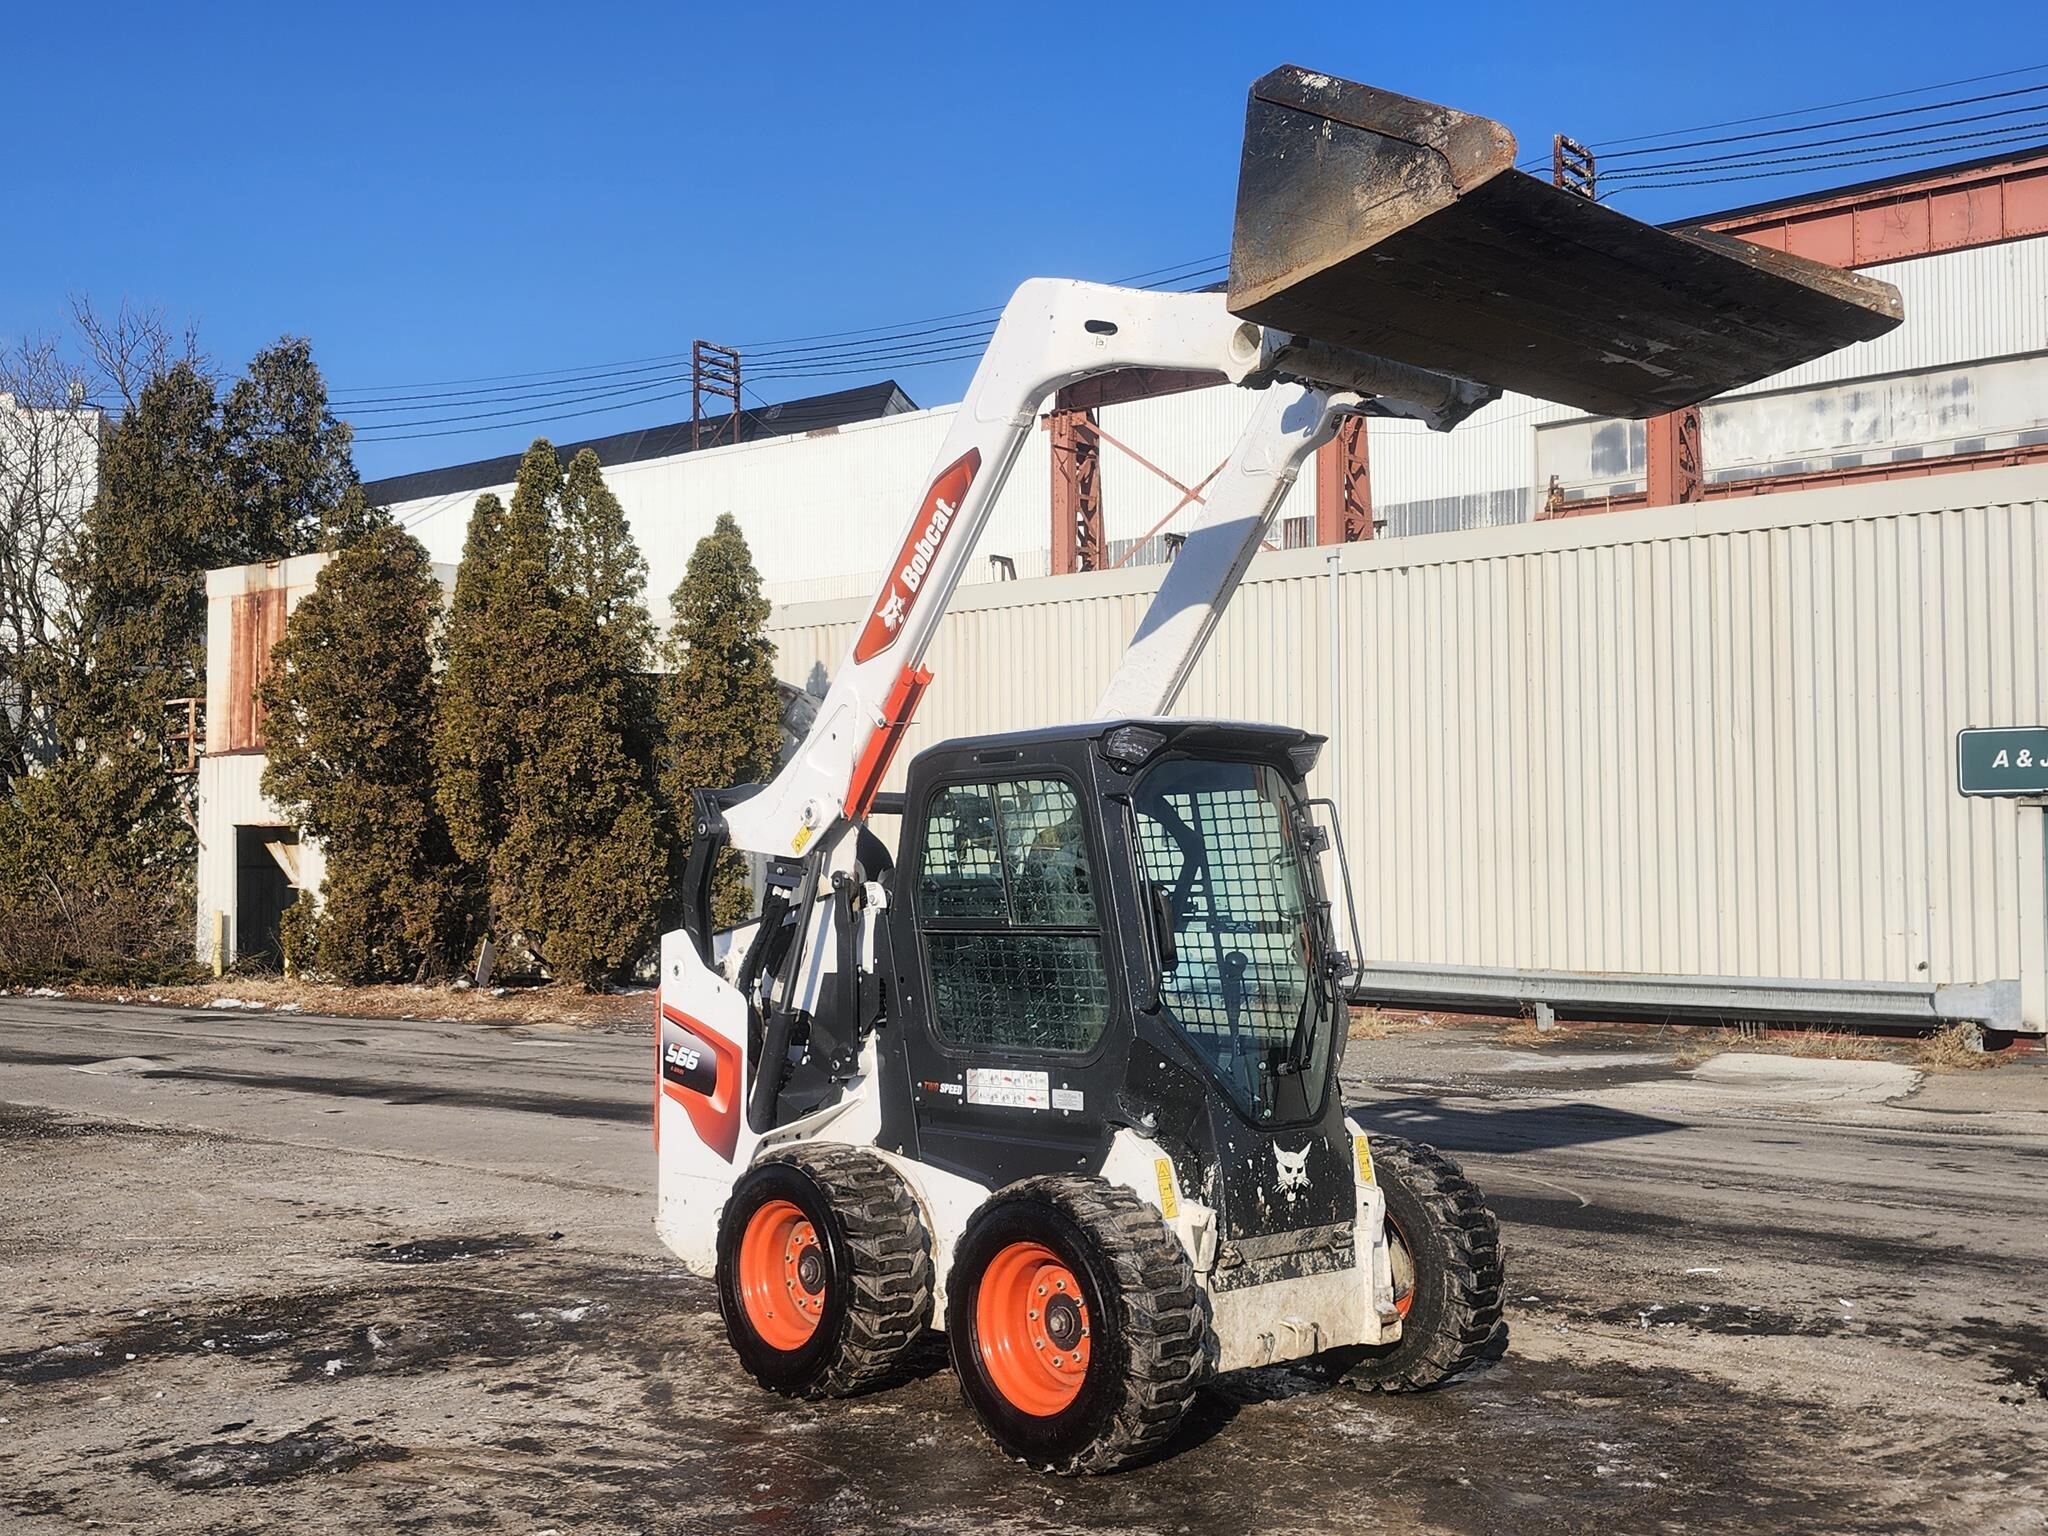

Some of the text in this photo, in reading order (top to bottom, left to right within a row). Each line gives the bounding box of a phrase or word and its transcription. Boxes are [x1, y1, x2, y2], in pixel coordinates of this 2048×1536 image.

[1991, 749, 2009, 768] A
[2016, 748, 2033, 768] &
[940, 1082, 963, 1095] SPEED
